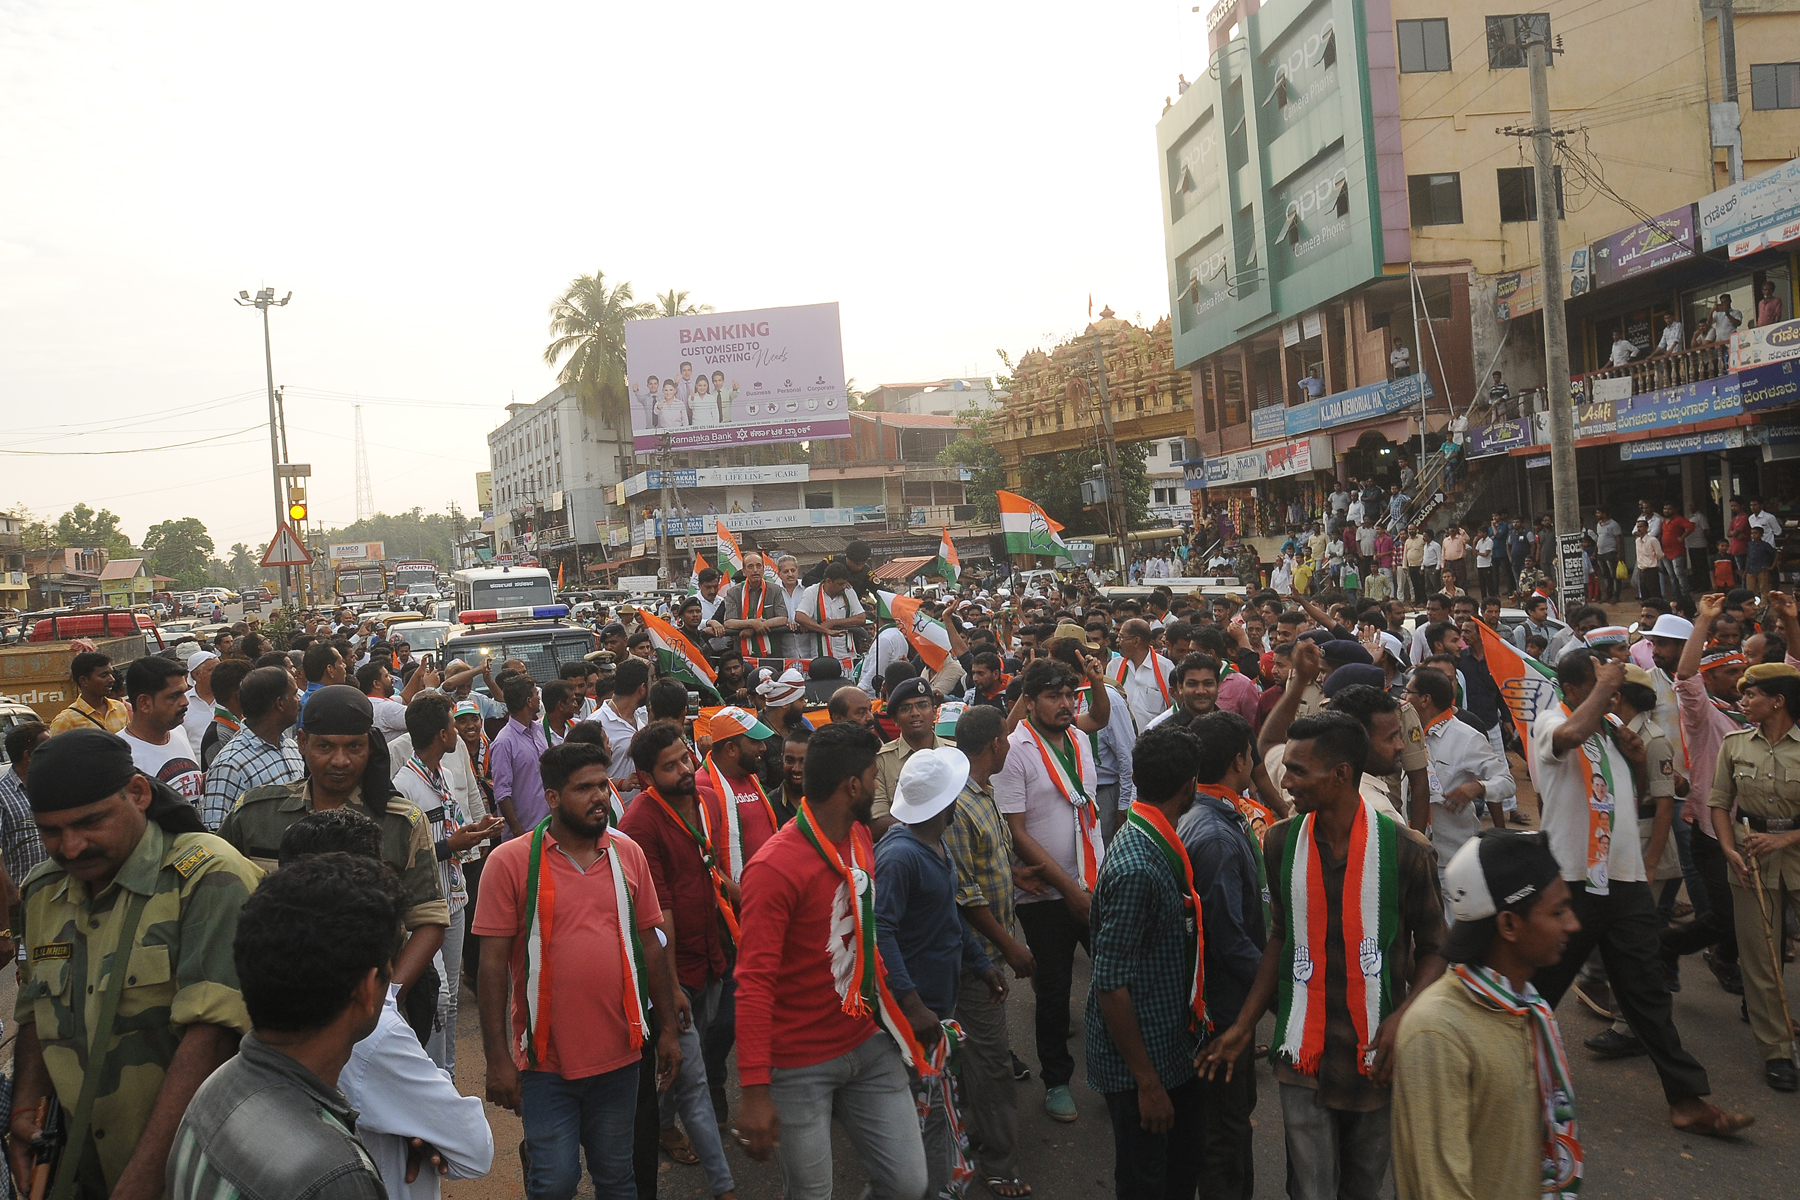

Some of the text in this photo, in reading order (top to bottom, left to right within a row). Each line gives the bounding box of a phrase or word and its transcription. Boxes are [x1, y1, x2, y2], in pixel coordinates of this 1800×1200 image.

[1284, 72, 1334, 121] Camera Phone
[1704, 194, 1737, 226] ಗಣೇಶ್
[1294, 220, 1346, 257] Camera Phone
[1736, 241, 1750, 252] SUN
[1196, 299, 1214, 316] Camera
[680, 322, 770, 344] BANKING
[1772, 326, 1800, 344] ಗಣೇ
[681, 342, 760, 356] CUSTOMISED TO
[705, 346, 788, 368] VARYING Needs
[807, 384, 835, 392] Corporate
[1744, 382, 1797, 404] ಬೆಂಗಳೂರು
[1320, 404, 1341, 422] K.L.RAO
[1342, 396, 1373, 417] MEMORIAL
[1373, 391, 1384, 408] HA
[1618, 410, 1657, 428] ಬೆಂಗಳೂರು
[1660, 398, 1708, 424] ಅಯ್ಯಂಗಾರ್
[1713, 393, 1741, 412] ಬೇಕರಿ
[1602, 422, 1616, 432] STORAGE
[670, 433, 732, 444] Karnataka Bank
[1632, 440, 1663, 453] ಬೆಂಗಳೂರು
[775, 470, 798, 478] iCARE
[726, 520, 746, 528] LIFE
[159, 761, 194, 780] ORIGINAL
